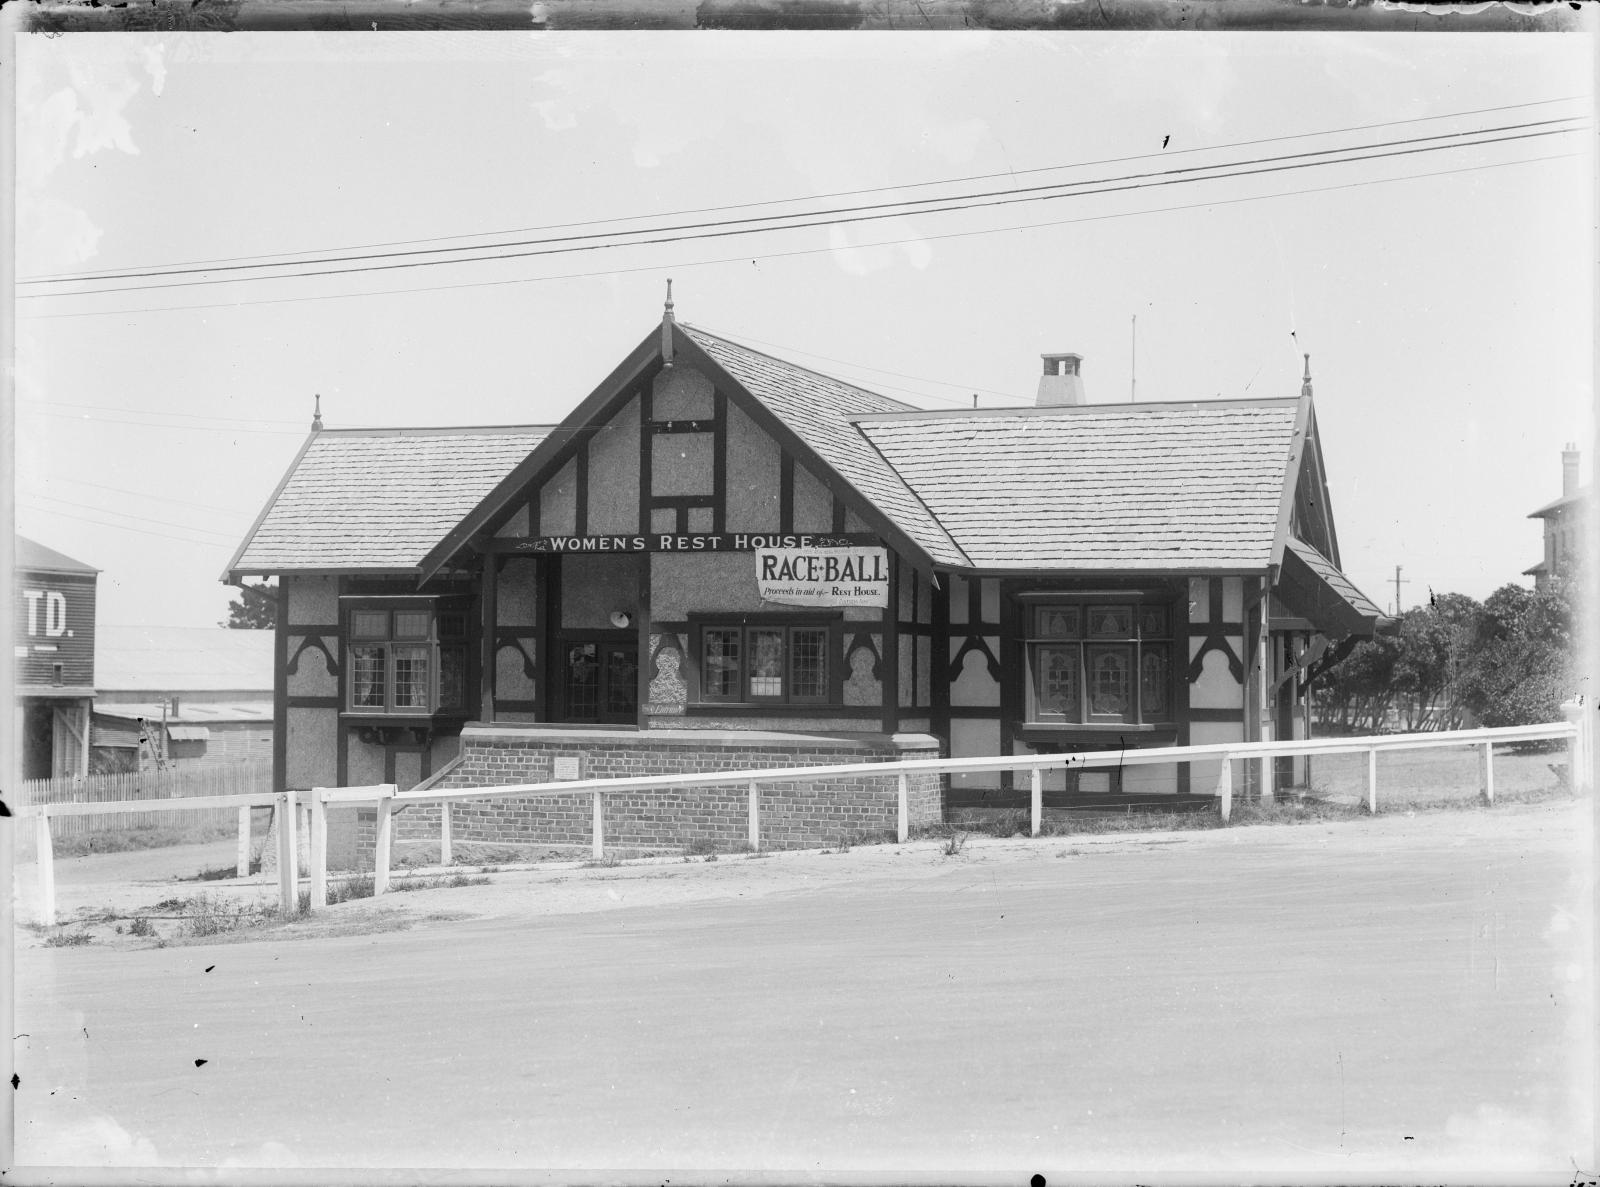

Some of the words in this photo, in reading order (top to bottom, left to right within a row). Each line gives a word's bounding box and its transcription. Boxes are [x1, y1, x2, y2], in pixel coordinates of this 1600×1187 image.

[550, 536, 646, 551] WOMENS
[660, 534, 722, 550] REST
[735, 534, 814, 549] HOUSE
[764, 587, 795, 595] Proceeds
[795, 587, 803, 595] in
[803, 587, 816, 596] aid
